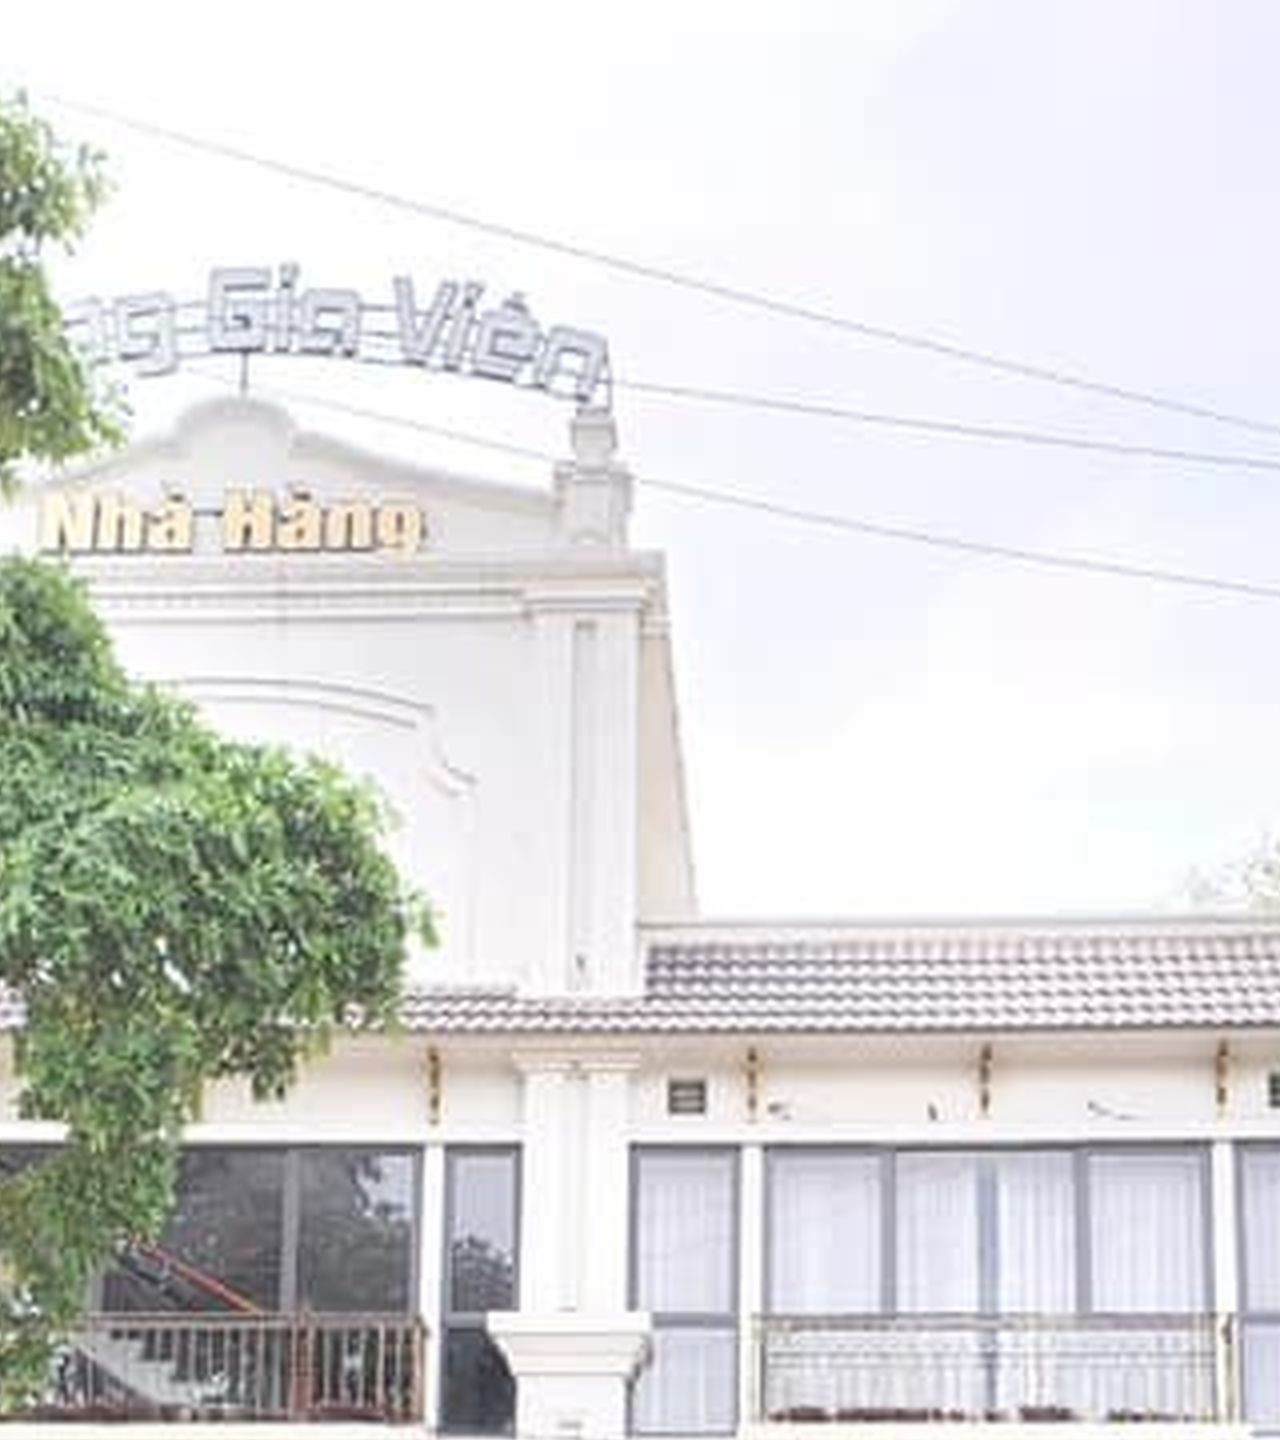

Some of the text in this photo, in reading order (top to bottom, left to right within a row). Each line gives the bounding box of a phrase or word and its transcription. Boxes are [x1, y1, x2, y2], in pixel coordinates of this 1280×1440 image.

[208, 262, 361, 356] Gia
[392, 274, 608, 403] Viên
[39, 480, 426, 557] Nhà Hàng
